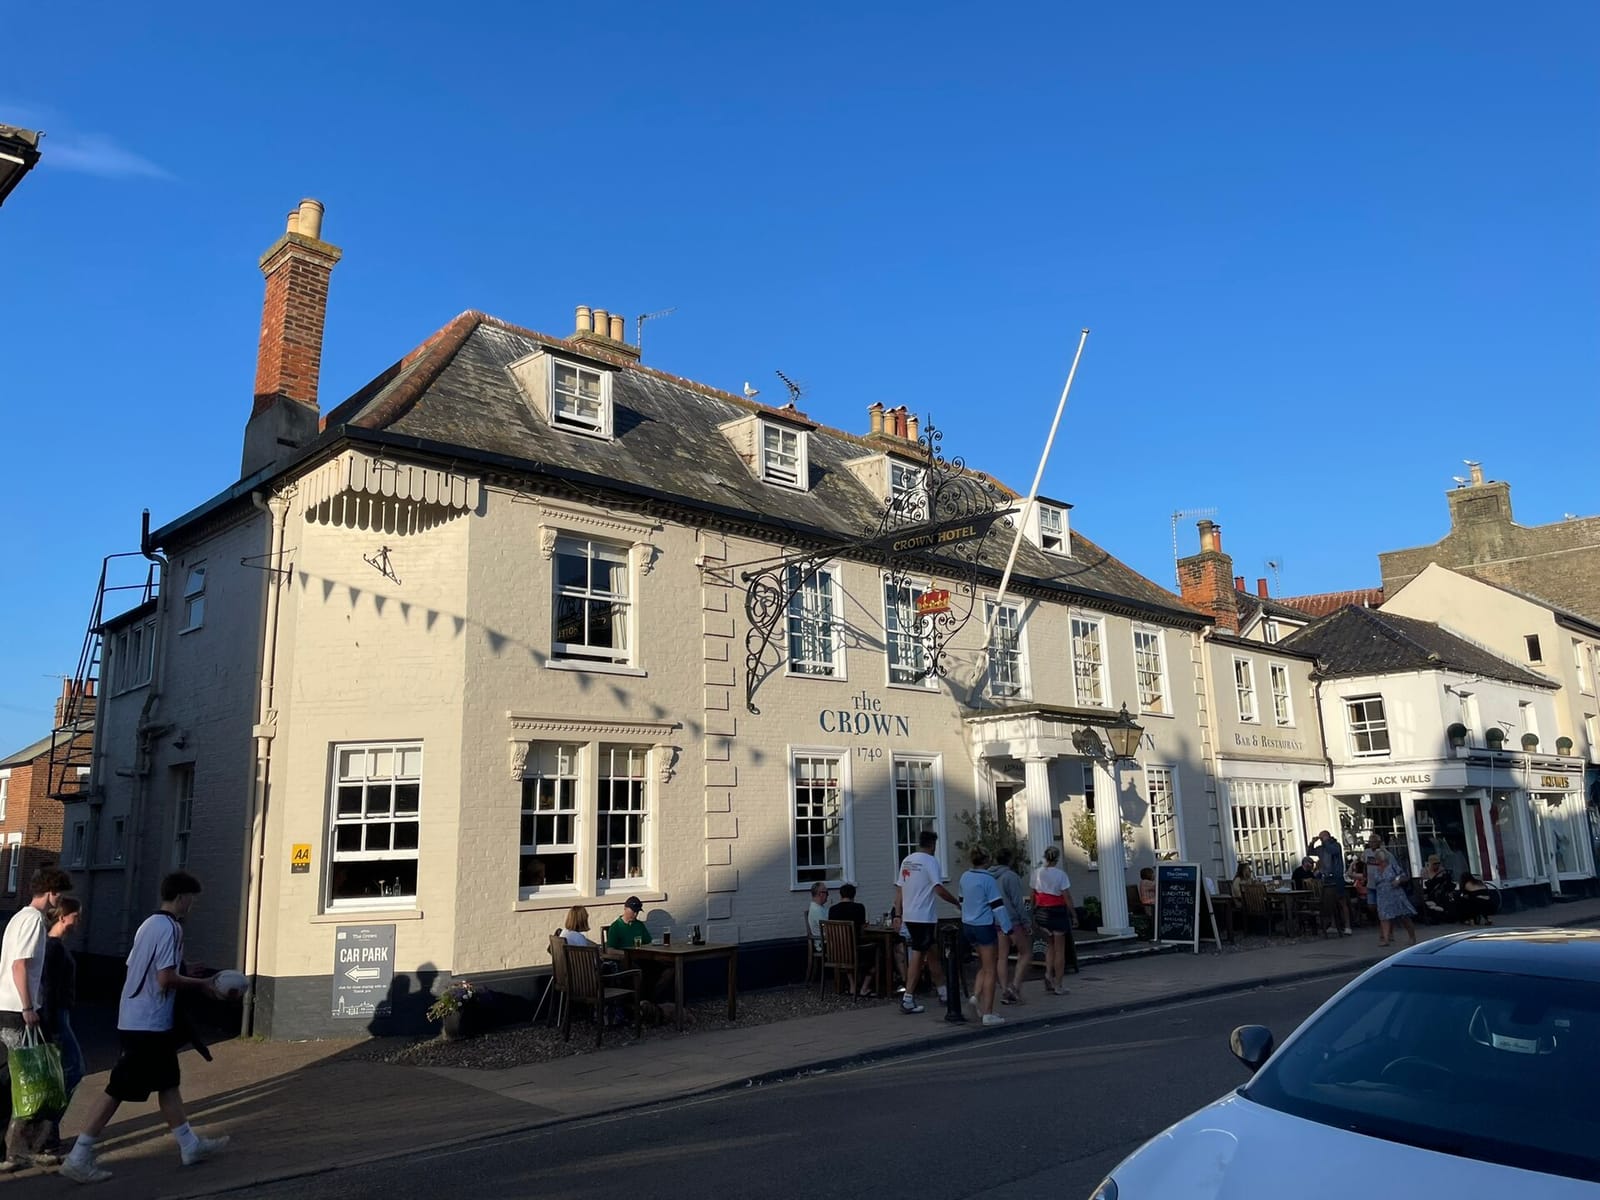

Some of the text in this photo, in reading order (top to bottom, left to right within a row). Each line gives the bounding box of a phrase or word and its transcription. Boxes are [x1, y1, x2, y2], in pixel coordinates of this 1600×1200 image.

[893, 526, 976, 551] CROWN HOTEL
[819, 709, 910, 737] CROWN
[1252, 734, 1258, 747] &
[857, 747, 882, 761] 1740
[1372, 774, 1431, 785] JACK WILLS
[295, 849, 309, 860] AA
[340, 947, 388, 963] CAR PARK
